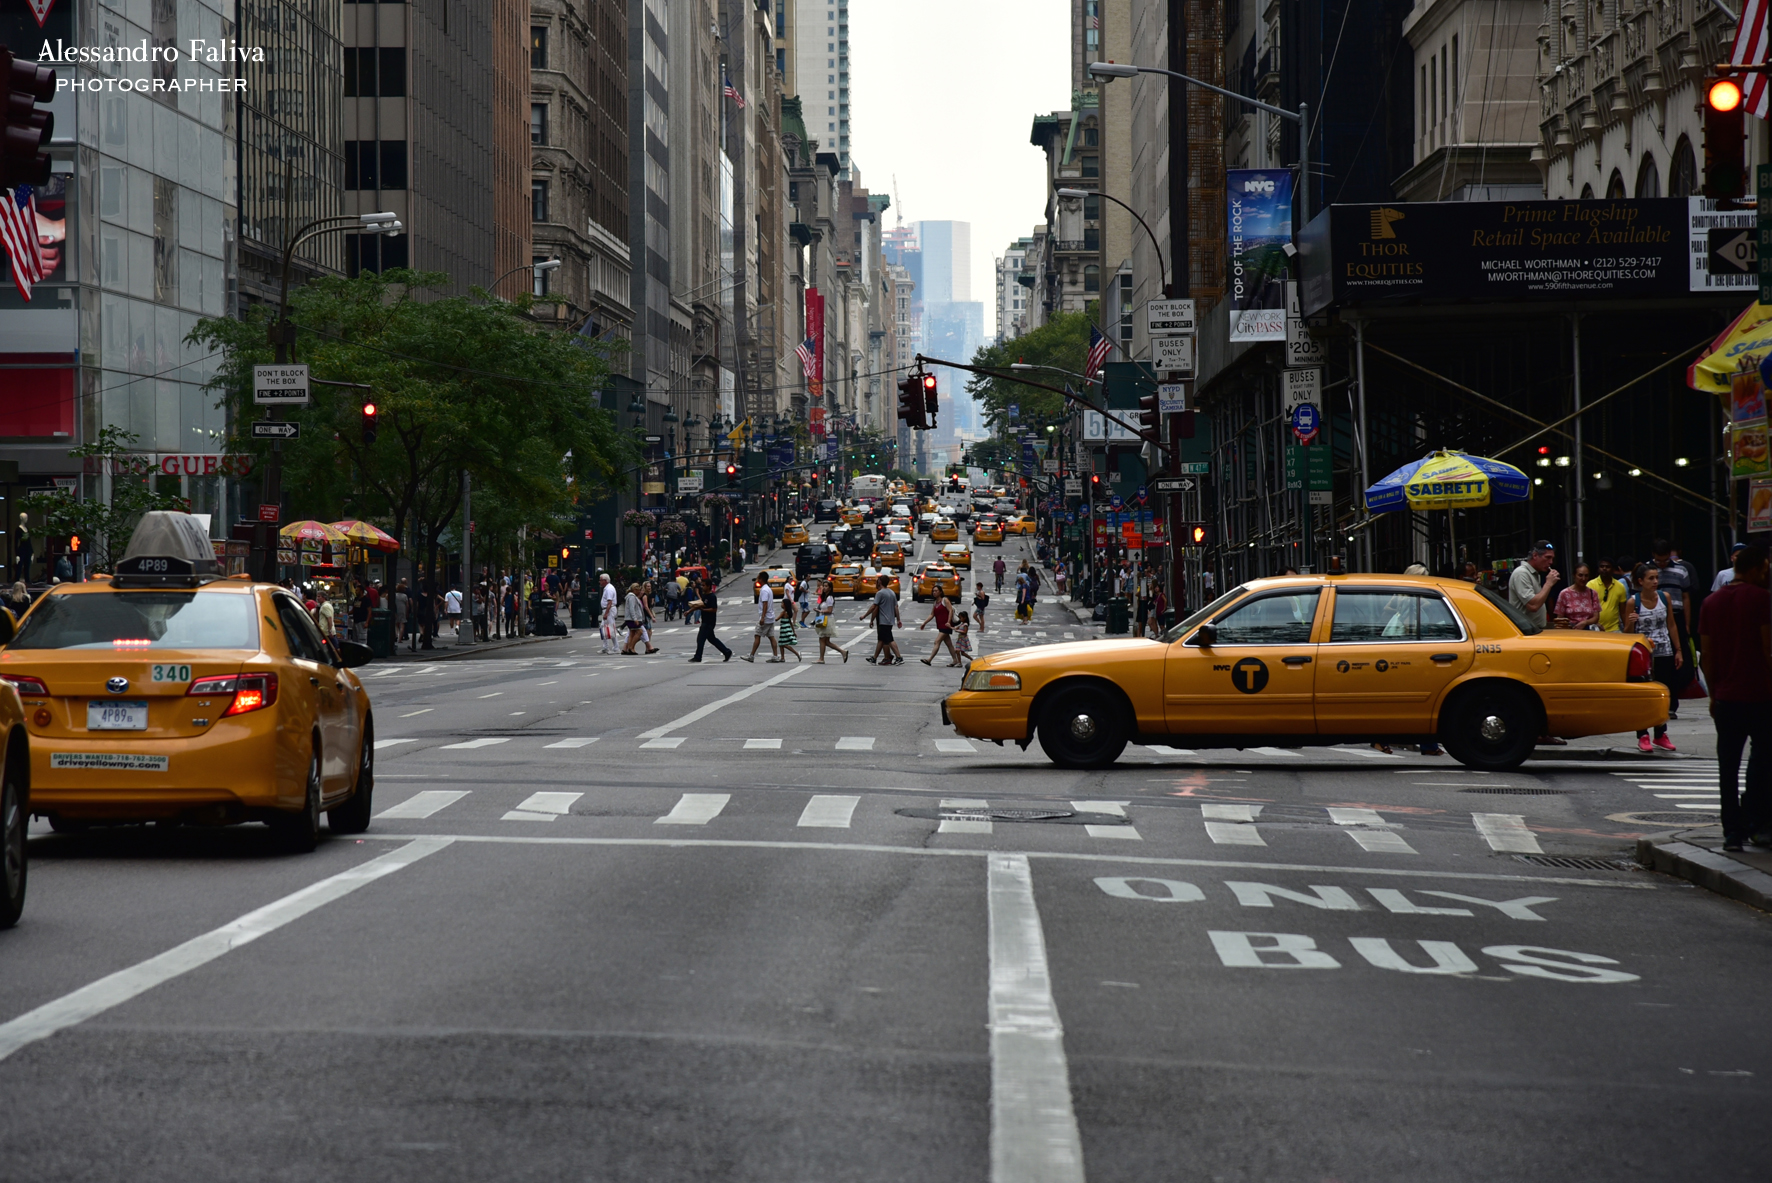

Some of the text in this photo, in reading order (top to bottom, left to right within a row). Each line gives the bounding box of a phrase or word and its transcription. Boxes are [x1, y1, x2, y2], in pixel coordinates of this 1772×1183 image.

[1244, 181, 1275, 192] NYC
[1502, 203, 1639, 227] Prime Flagship
[1691, 215, 1718, 228] CONDITIONS
[1725, 215, 1736, 228] THIS
[1736, 214, 1751, 228] WORK
[1471, 225, 1671, 250] Retail Space Available
[1232, 200, 1244, 301] TOP OF THE ROCK
[1358, 242, 1410, 256] THOR
[1735, 242, 1758, 260] ON
[1481, 256, 1662, 270] MICHAEL WORTHMAN (212) 529-7417
[1346, 262, 1424, 279] EQUITIES
[1487, 268, 1656, 283] MWORTHMAN@THOREQUITIES.COM
[1527, 282, 1614, 291] www.590fifthavenue.com
[1239, 312, 1282, 321] NEW YORK
[1236, 321, 1283, 336] CityPASS
[1298, 331, 1311, 339] FIN
[1158, 340, 1185, 348] BUSES
[281, 369, 305, 377] BLOCK
[1289, 371, 1315, 383] BUSES
[273, 389, 283, 397] +2
[284, 389, 304, 397] POINTS
[1292, 390, 1312, 402] ONLY
[1089, 412, 1126, 438] 554
[162, 455, 250, 475] GUESS
[1409, 481, 1485, 496] SABRETT
[138, 559, 168, 572] 4P89
[1476, 644, 1502, 654] 2N35
[153, 665, 190, 682] 340
[1240, 664, 1261, 690] T
[57, 759, 161, 769] driveyellownyc.com
[1093, 875, 1561, 922] ONLY
[1206, 929, 1642, 985] BUS
